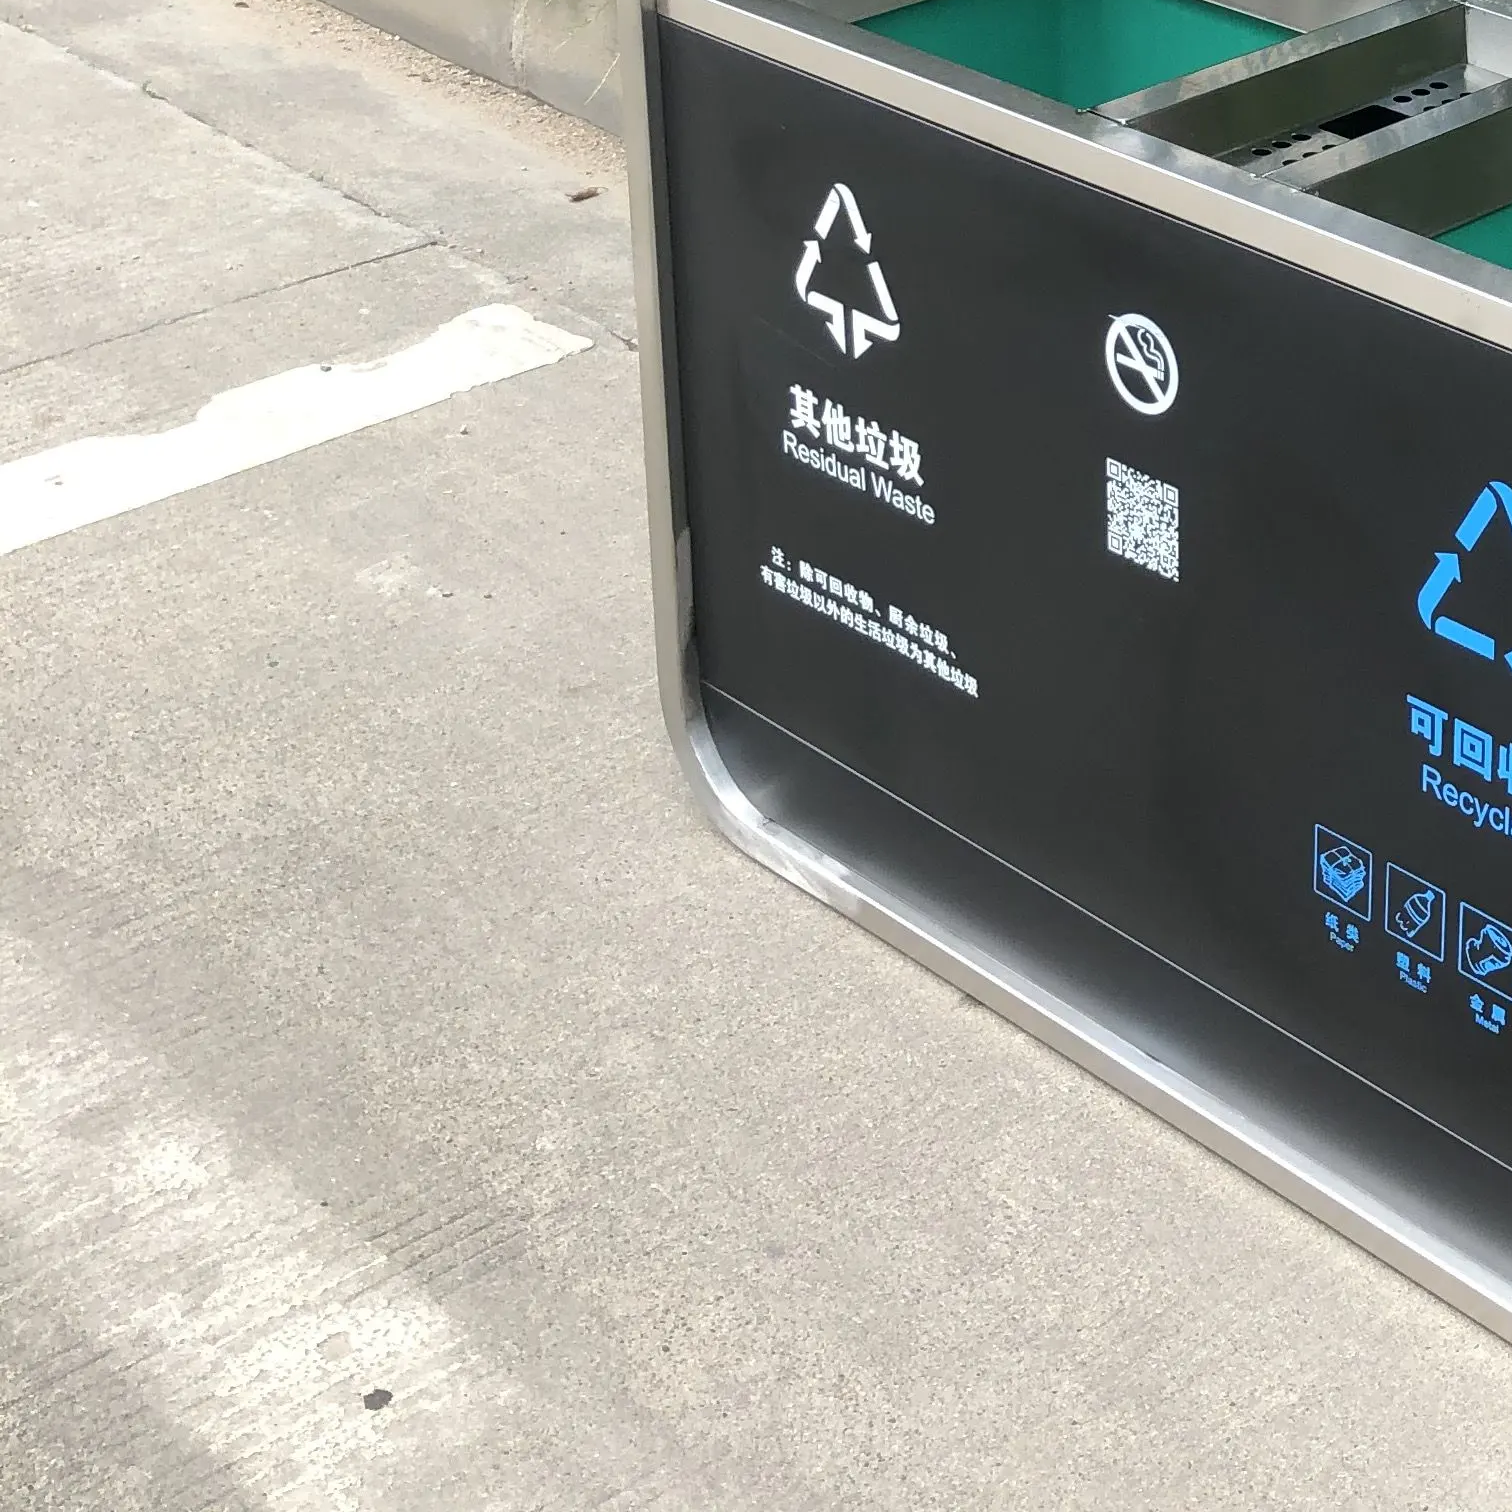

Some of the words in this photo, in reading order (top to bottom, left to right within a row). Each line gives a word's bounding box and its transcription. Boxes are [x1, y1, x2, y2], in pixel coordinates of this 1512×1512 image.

[782, 429, 866, 492] Residual
[870, 470, 936, 525] Waste
[789, 384, 925, 487] 其他垃圾
